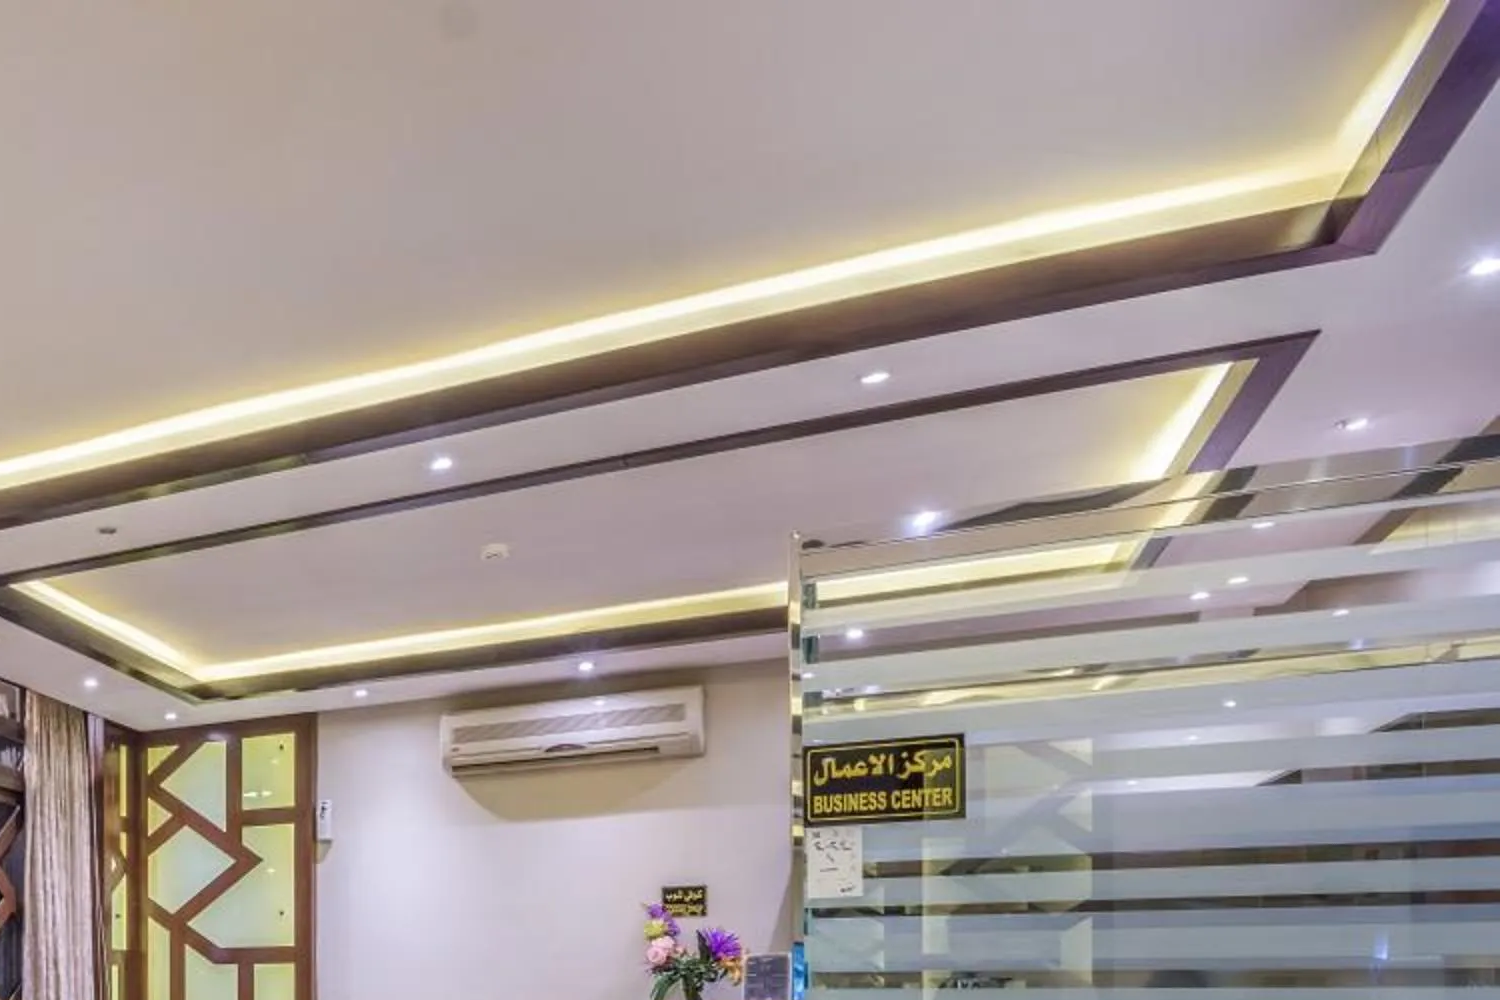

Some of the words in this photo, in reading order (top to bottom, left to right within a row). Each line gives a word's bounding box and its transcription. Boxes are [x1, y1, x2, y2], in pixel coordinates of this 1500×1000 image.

[896, 750, 953, 779] مركز
[813, 791, 887, 814] BUSINESS
[891, 787, 953, 809] CENTER
